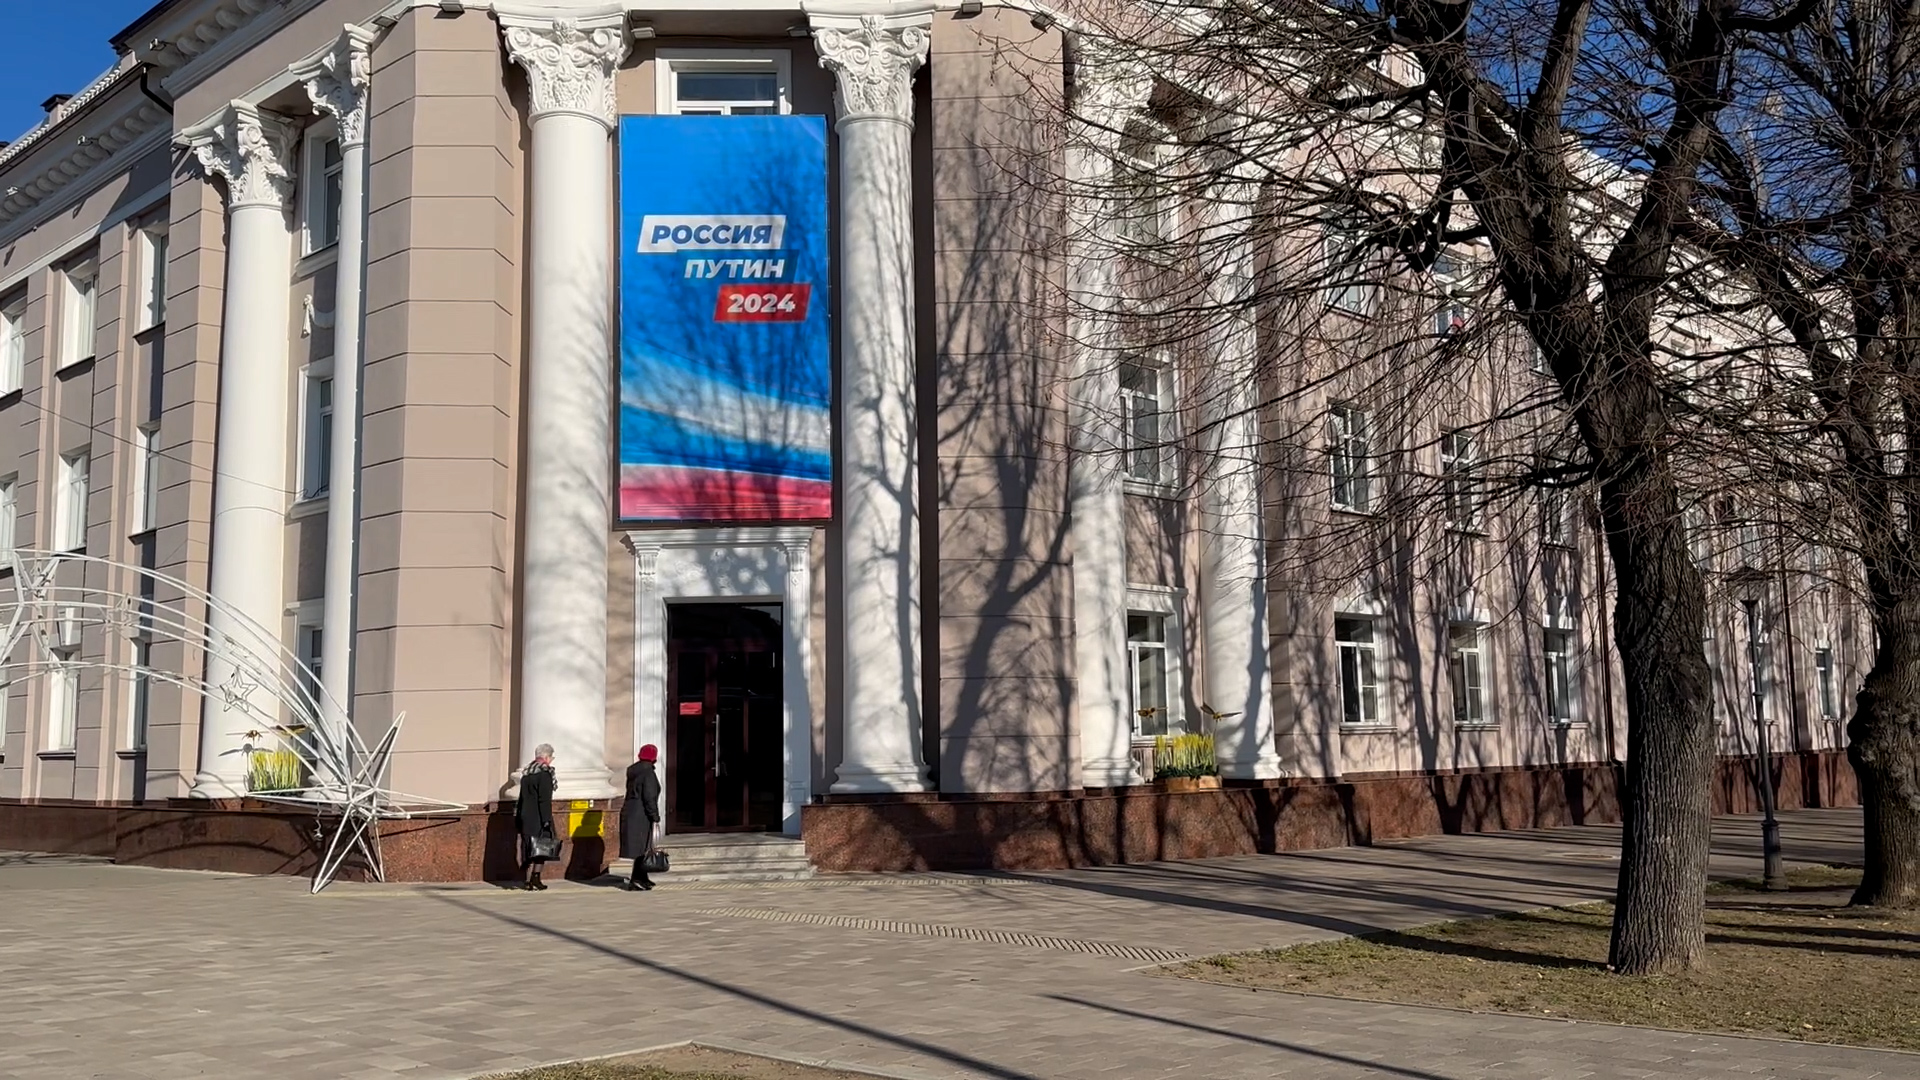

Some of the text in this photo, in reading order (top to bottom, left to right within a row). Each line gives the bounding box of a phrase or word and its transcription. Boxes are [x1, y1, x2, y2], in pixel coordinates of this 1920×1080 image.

[651, 225, 772, 244] РОССИЯ
[684, 259, 785, 278] ПУТИН
[727, 293, 796, 314] 2024
